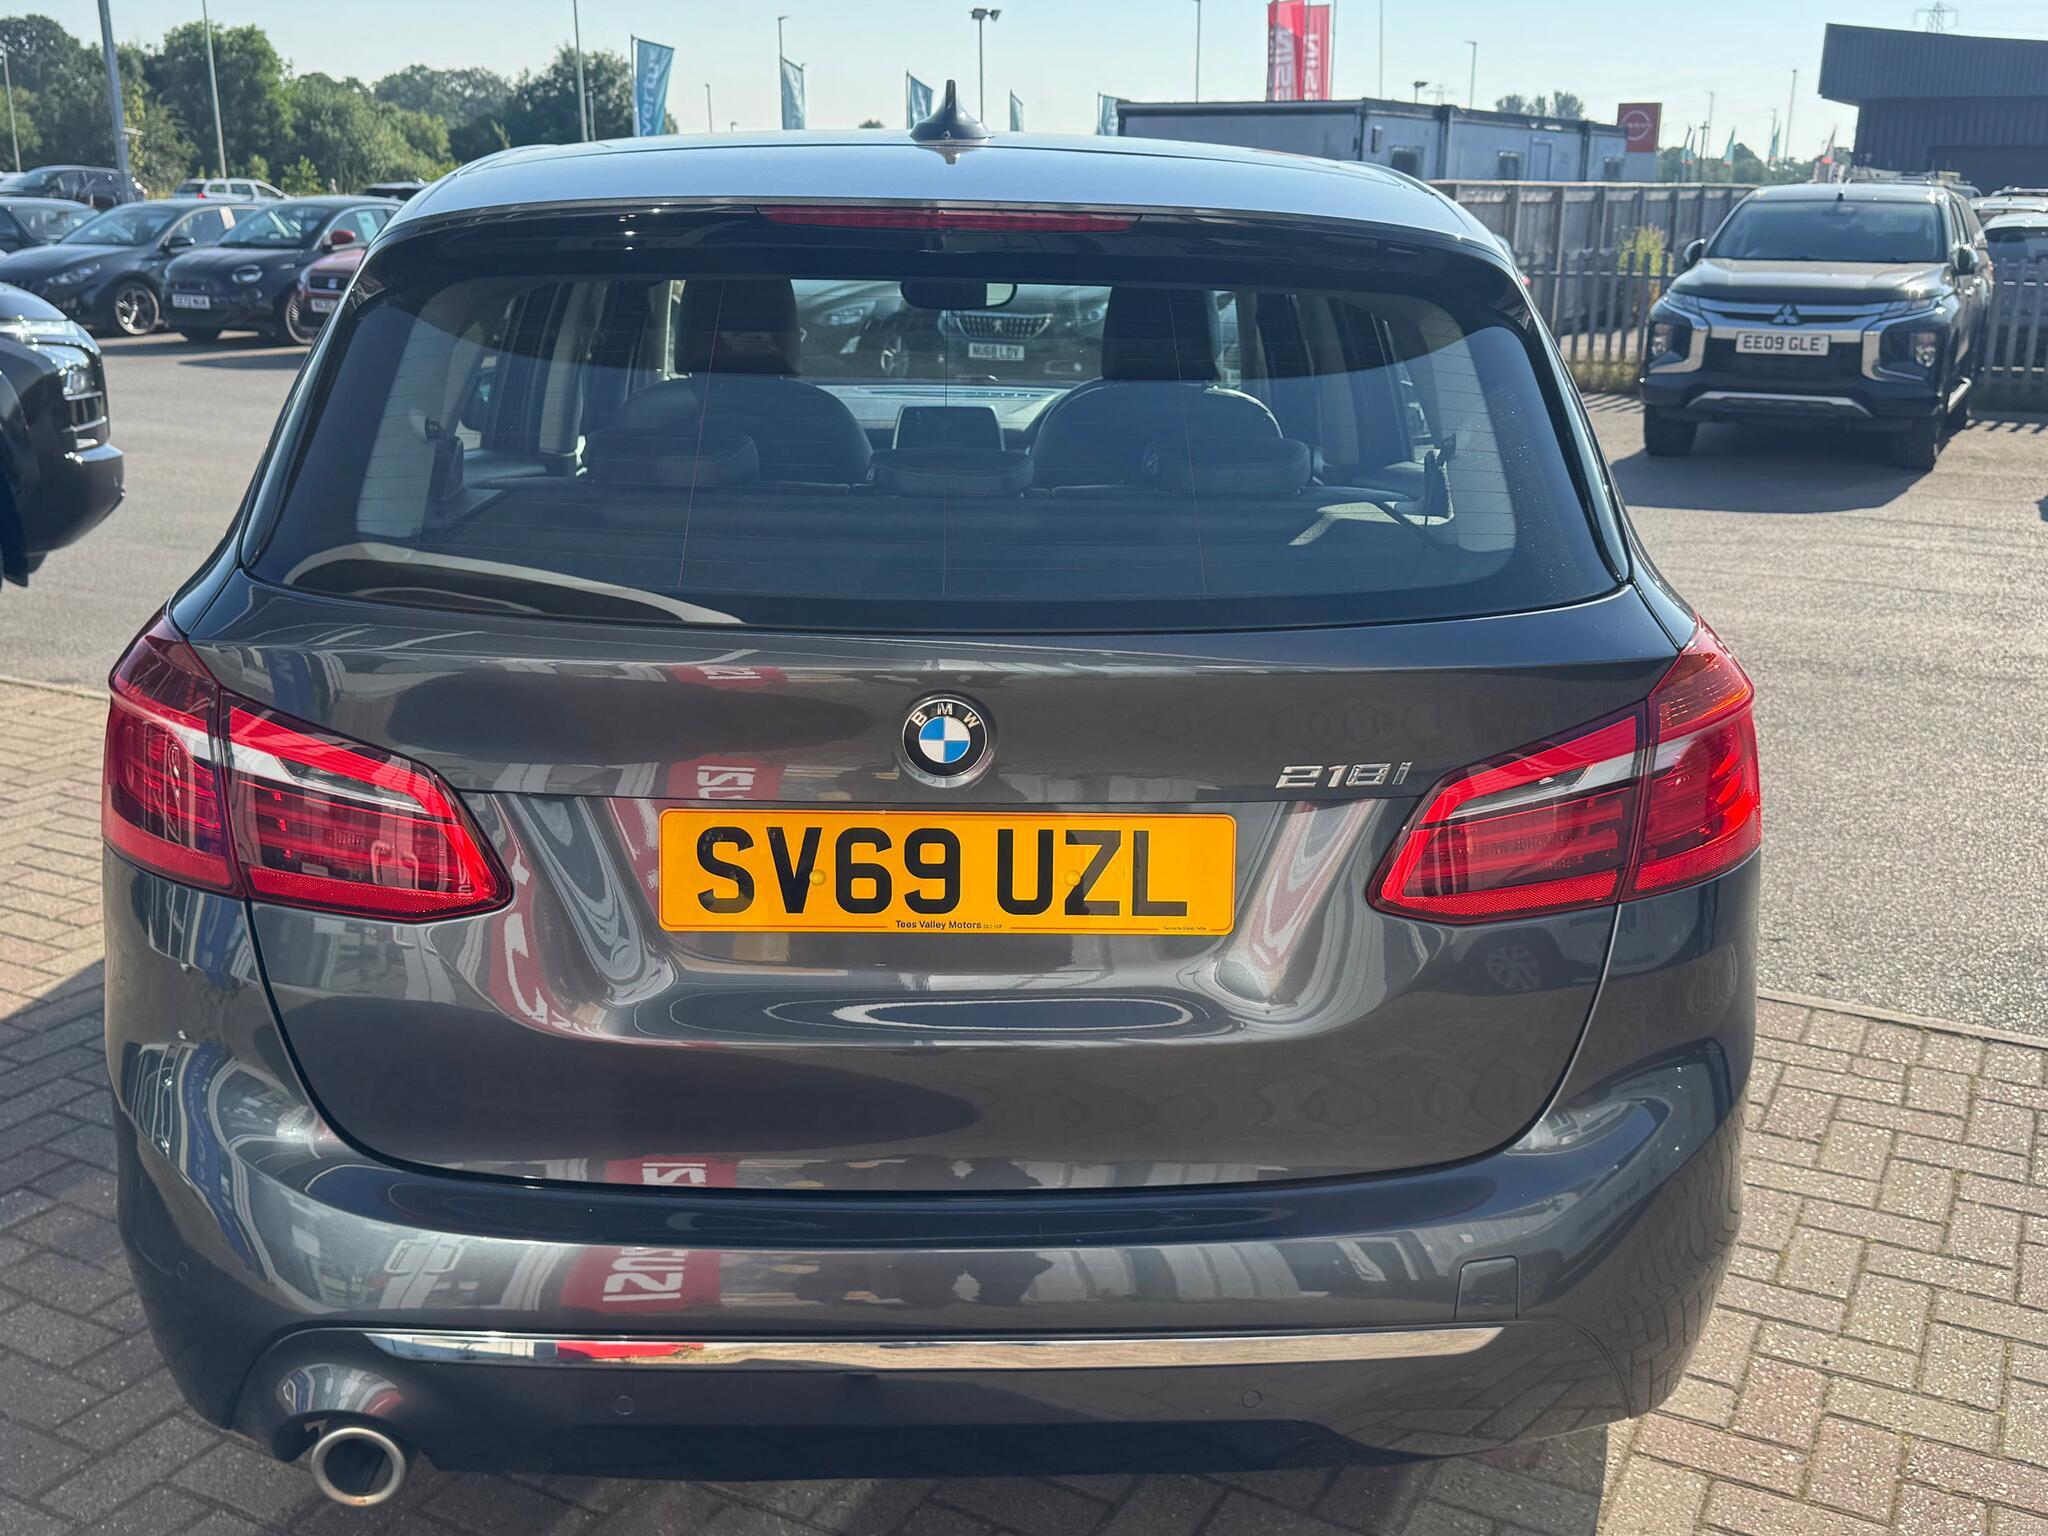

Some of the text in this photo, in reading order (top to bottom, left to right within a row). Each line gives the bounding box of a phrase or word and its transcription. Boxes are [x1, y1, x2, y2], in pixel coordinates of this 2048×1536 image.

[1743, 334, 1820, 352] EE09 GLE
[911, 702, 980, 728] BMW
[1275, 762, 1413, 789] 218i
[696, 826, 1188, 917] SV69 UZL
[896, 920, 917, 929] Tees
[919, 920, 946, 931] Valley
[948, 921, 982, 929] Motors
